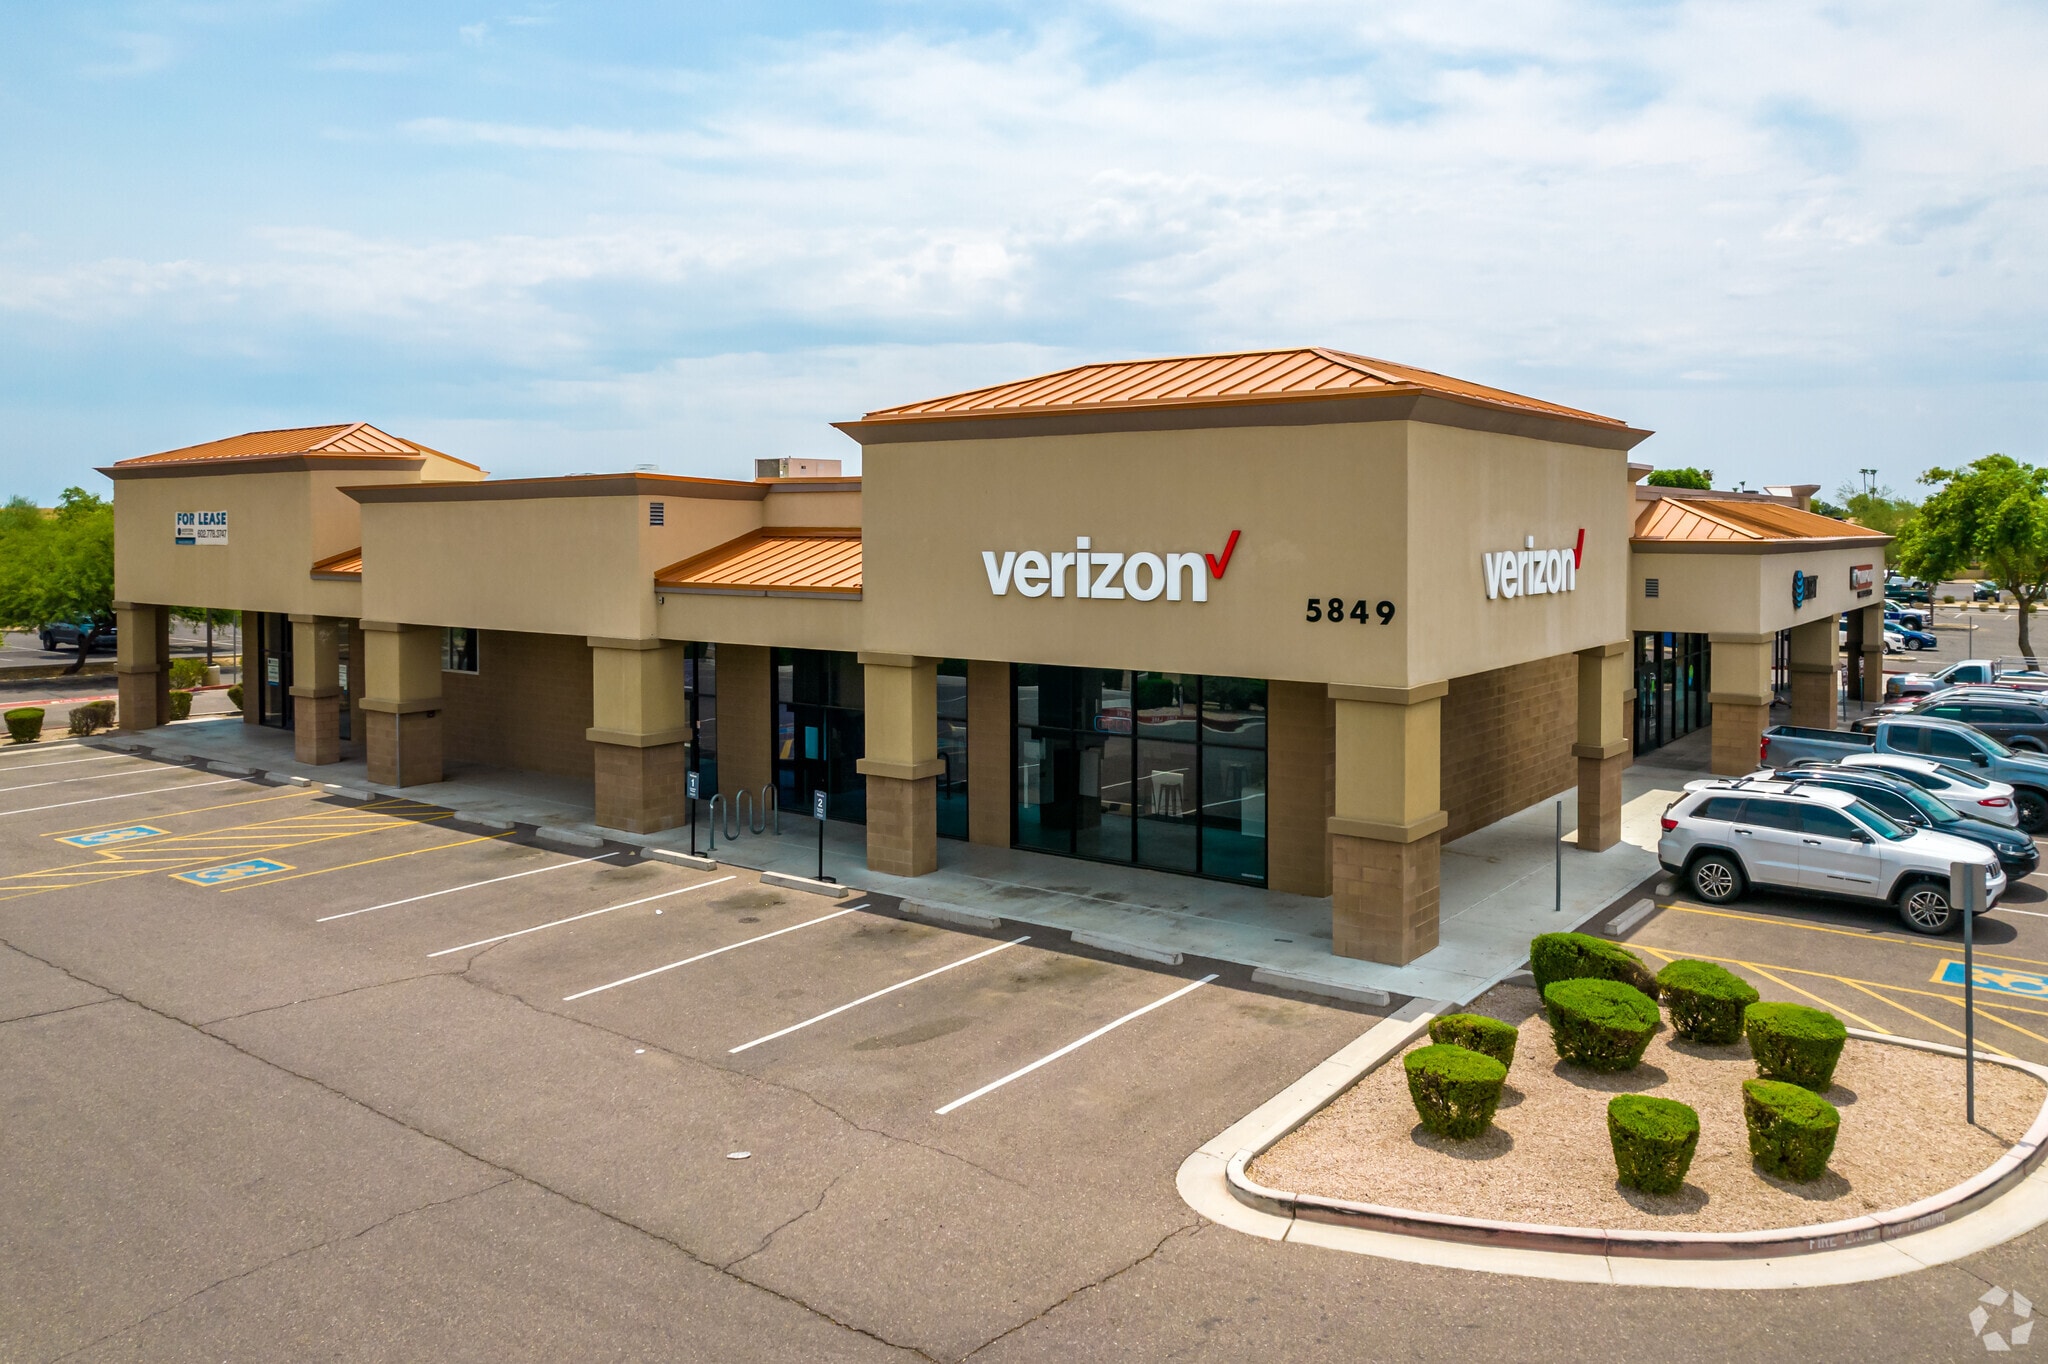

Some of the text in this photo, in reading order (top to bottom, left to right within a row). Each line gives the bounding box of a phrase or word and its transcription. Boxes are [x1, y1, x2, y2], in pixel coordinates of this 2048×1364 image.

[177, 512, 226, 525] FOR LEASE
[981, 536, 1208, 603] verizon
[1481, 535, 1576, 600] verizon
[1306, 597, 1396, 625] 5849
[817, 798, 823, 808] 2
